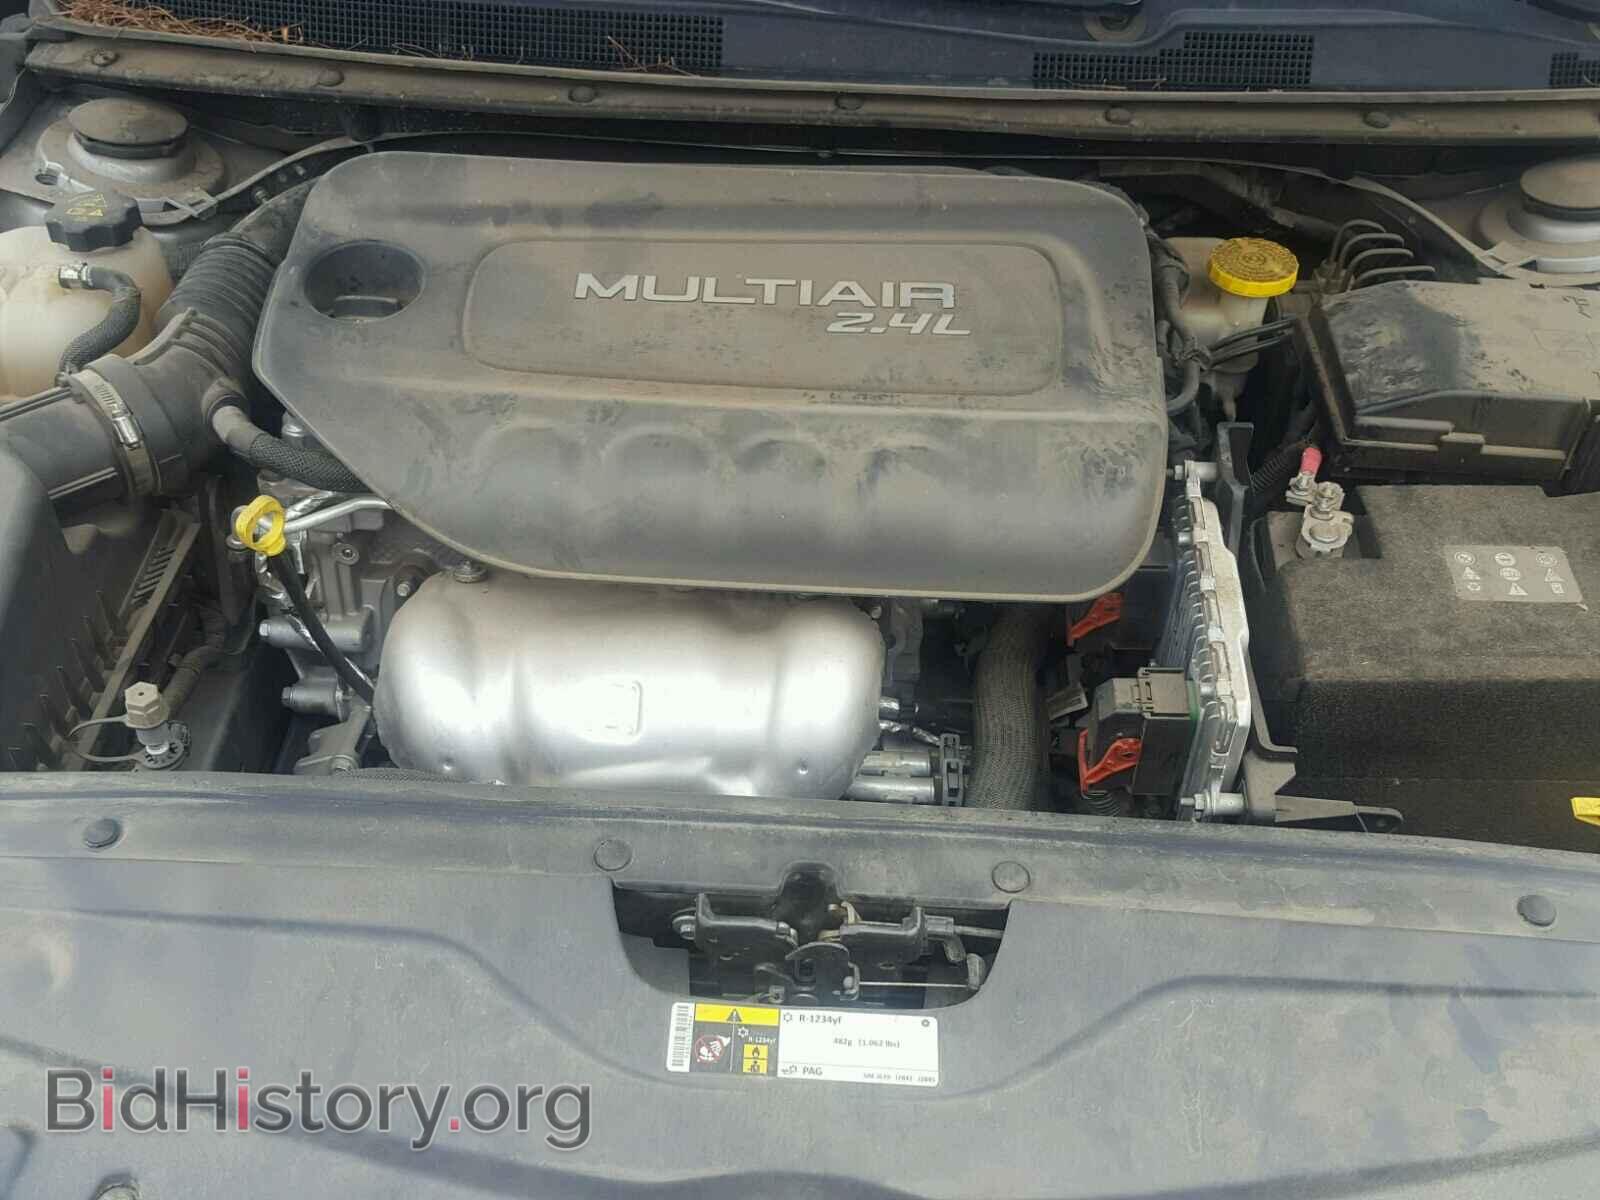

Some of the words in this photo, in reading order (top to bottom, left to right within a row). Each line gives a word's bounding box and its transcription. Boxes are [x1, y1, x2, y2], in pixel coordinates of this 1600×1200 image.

[574, 272, 955, 309] MULTIAIR
[826, 312, 971, 335] 2.4L
[799, 1014, 843, 1026] R-1234yf
[802, 1066, 823, 1076] PAG
